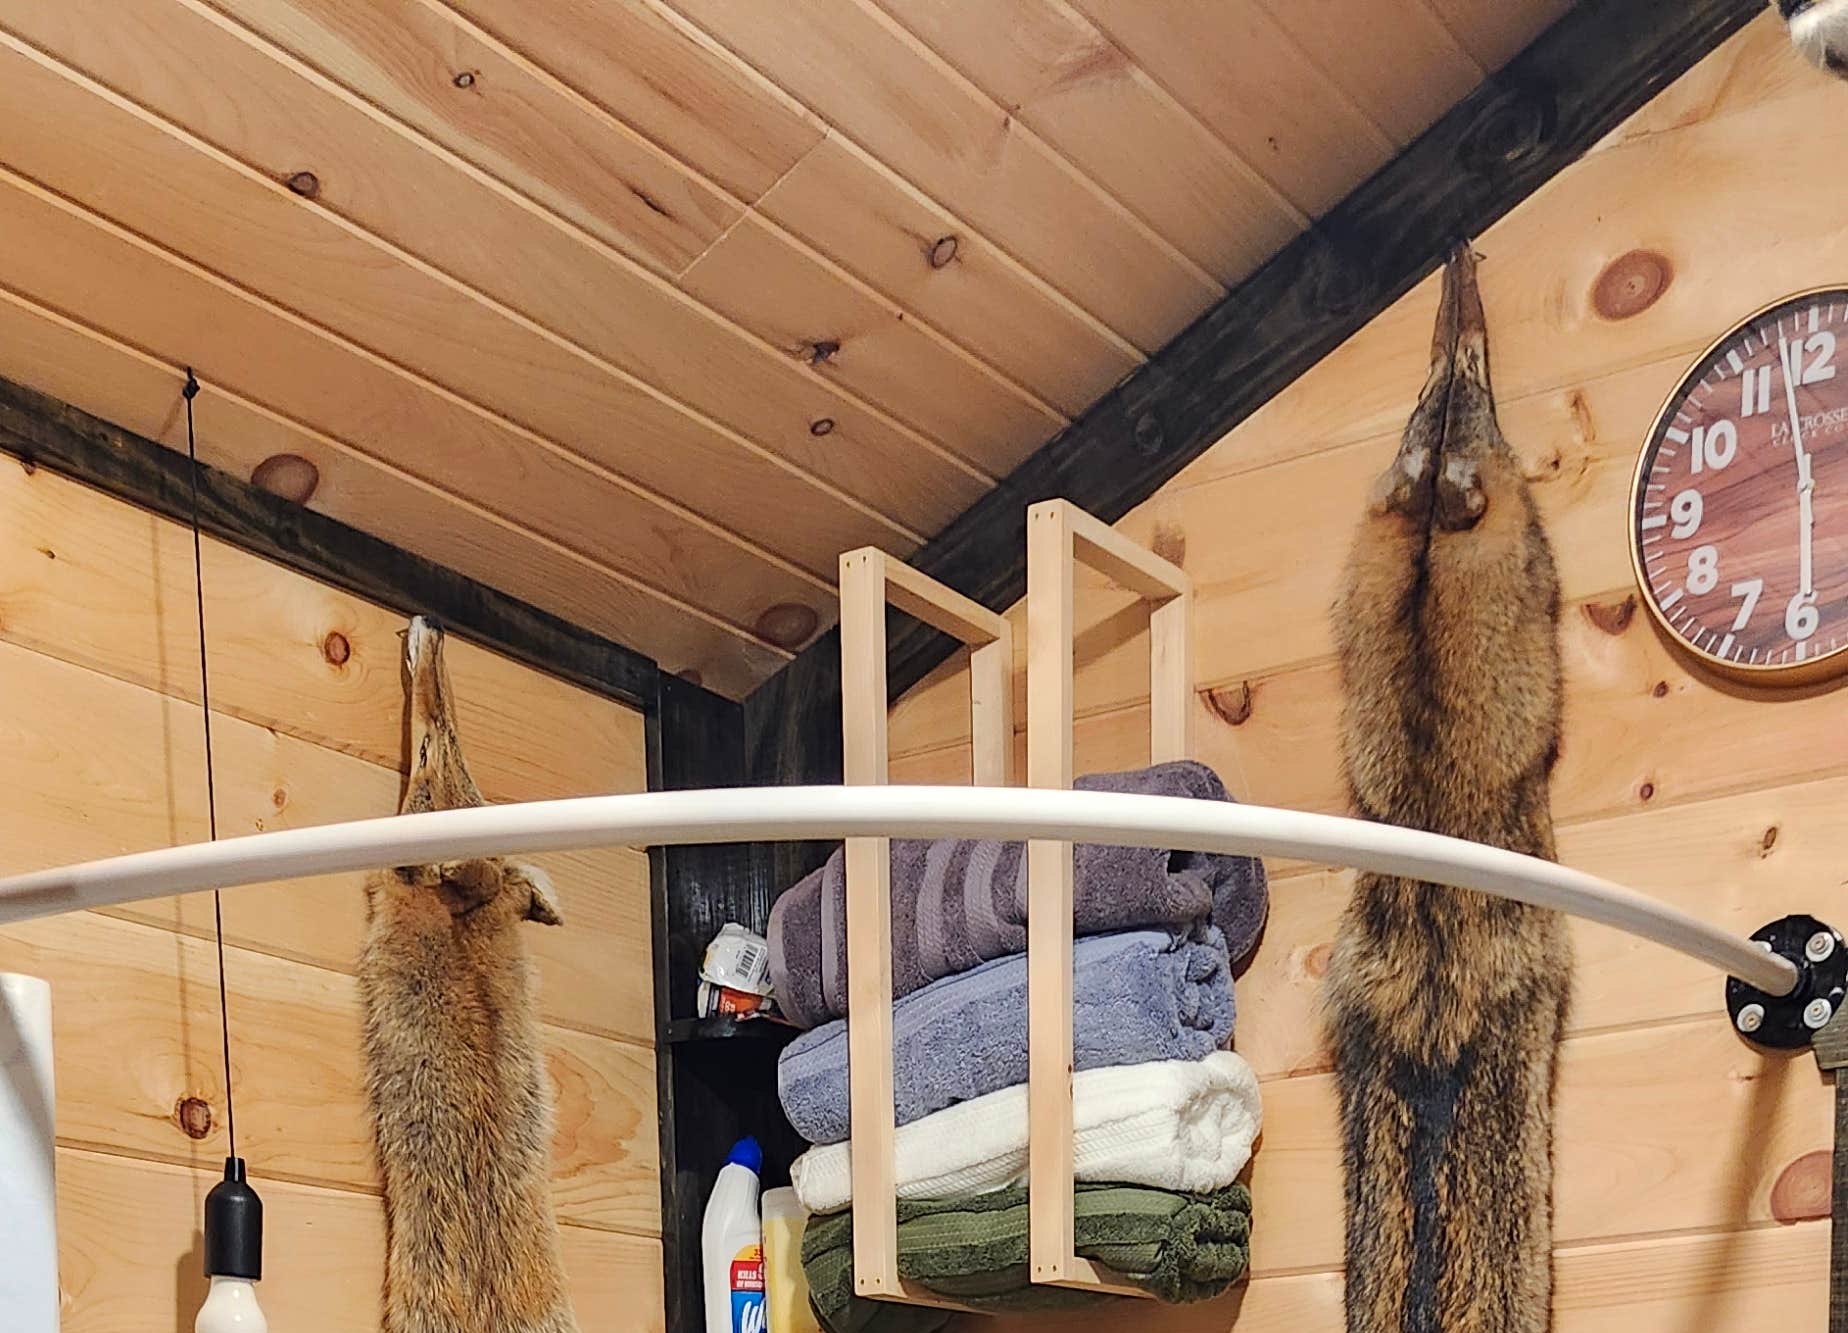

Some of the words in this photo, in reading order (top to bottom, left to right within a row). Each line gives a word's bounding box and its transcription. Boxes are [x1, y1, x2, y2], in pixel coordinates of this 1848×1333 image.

[1789, 330, 1836, 387] 12
[1740, 365, 1771, 418] 11
[1690, 419, 1738, 475] 10
[1670, 489, 1703, 540] 9
[1686, 545, 1719, 596] 8
[1730, 578, 1763, 632] 7
[1785, 591, 1819, 641] 6
